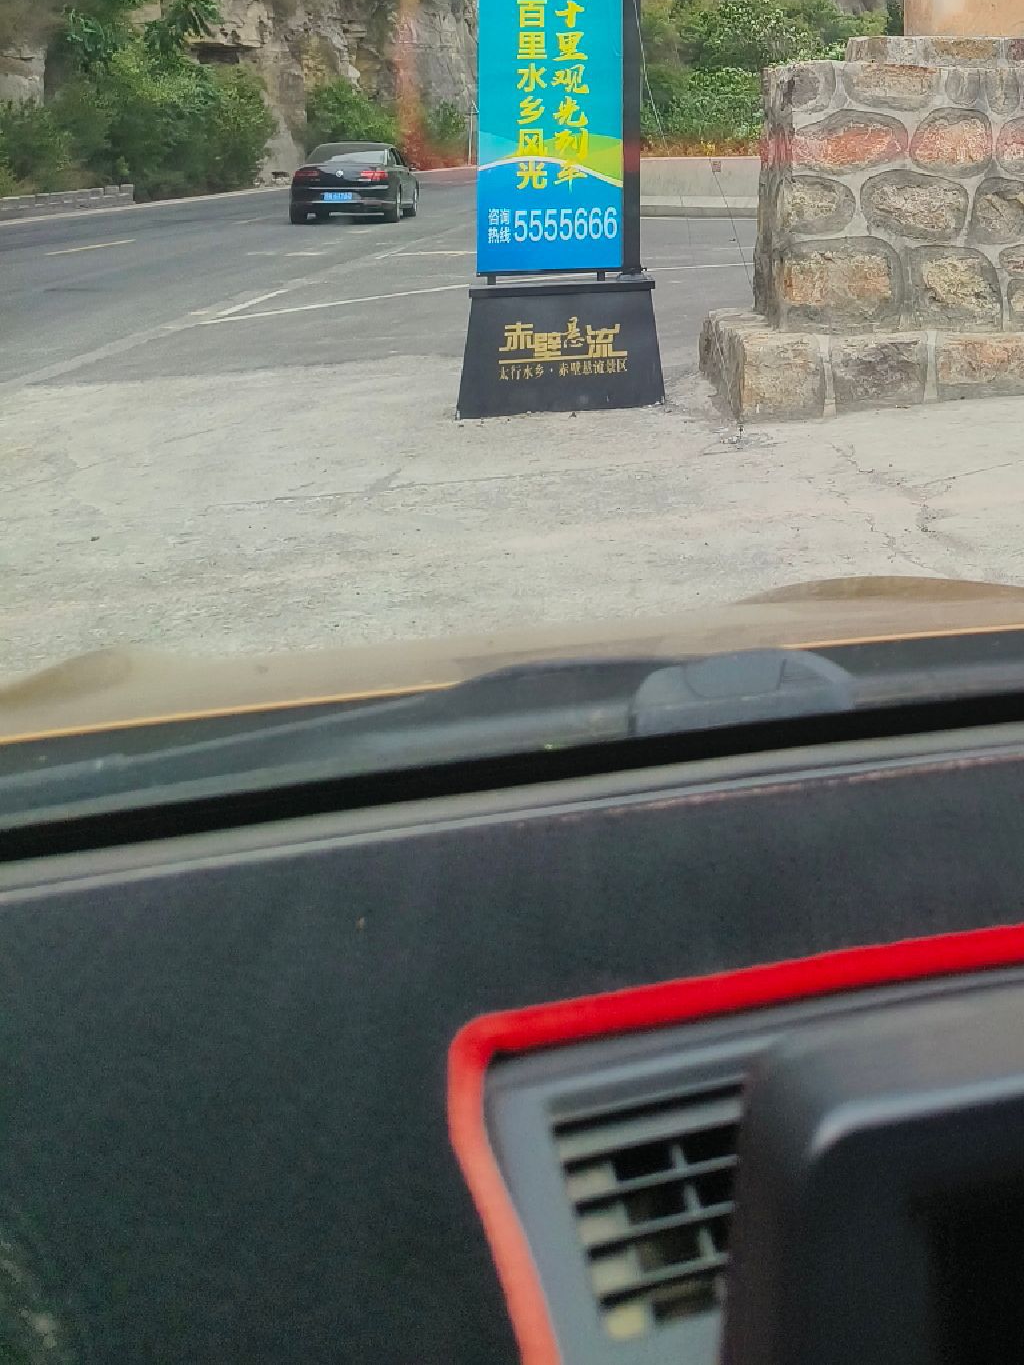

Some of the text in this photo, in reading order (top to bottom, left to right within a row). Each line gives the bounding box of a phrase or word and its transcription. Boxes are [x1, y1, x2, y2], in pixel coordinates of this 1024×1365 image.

[514, 207, 618, 241] 5555666
[499, 316, 627, 361] 赤壁悬流
